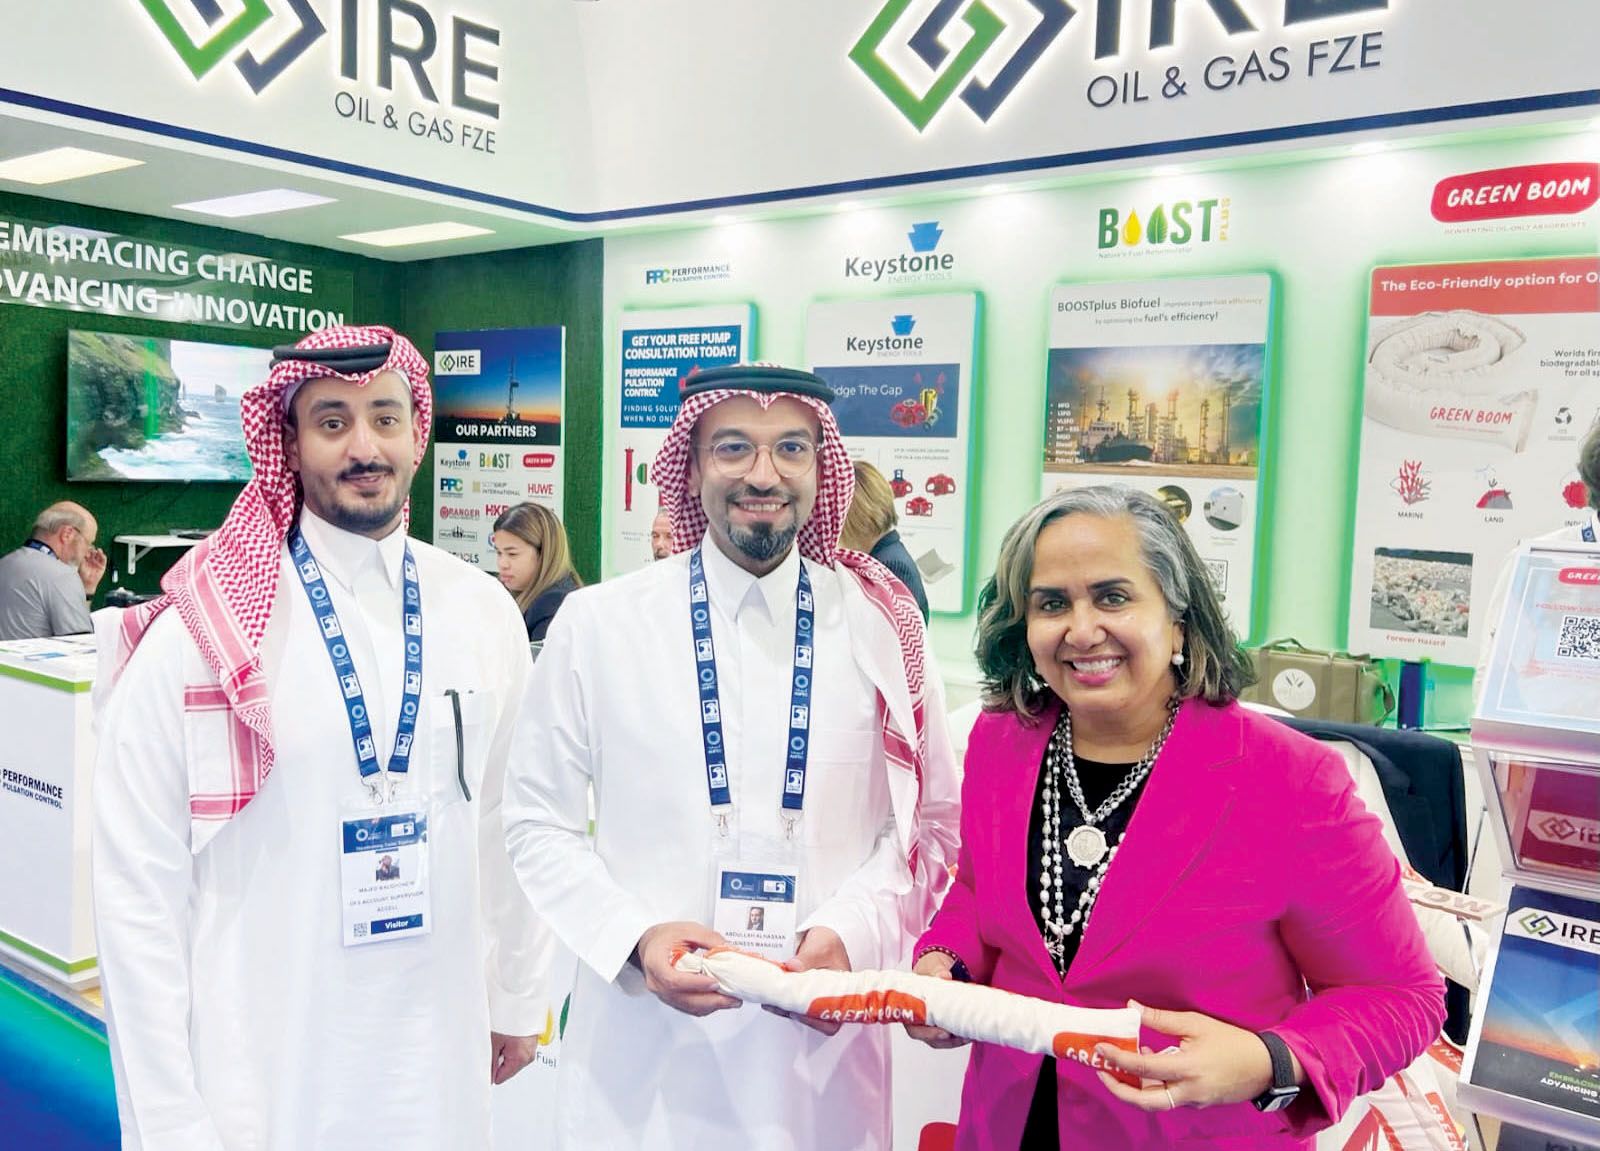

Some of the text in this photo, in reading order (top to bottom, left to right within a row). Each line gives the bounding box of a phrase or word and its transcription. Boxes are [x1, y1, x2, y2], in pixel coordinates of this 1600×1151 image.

[340, 0, 500, 119] IRE
[1087, 31, 1383, 107] OIL & GAS FZE
[334, 91, 496, 154] OIL & GAS FZE
[1447, 176, 1591, 208] GREEN BOOM
[0, 221, 313, 295] EMBRACING CHANGE
[672, 264, 730, 276] PERFORMANCE
[845, 253, 954, 282] Keystone
[646, 268, 671, 285] PPC
[1381, 281, 1407, 292] The
[1410, 275, 1502, 292] Eco-Friendly
[1505, 272, 1555, 290] option
[1558, 272, 1583, 285] for
[0, 269, 344, 332] VANCING INNOVATION
[1057, 299, 1117, 313] BOOSTplus
[1120, 297, 1160, 309] Biofuel
[1170, 311, 1218, 322] efficiency!
[632, 332, 731, 347] GET YOUR FREE PUMP
[847, 336, 923, 355] Keystone
[625, 345, 737, 360] CONSULTATION TODAY!
[1555, 349, 1585, 358] Worlds
[456, 355, 475, 368] IRE
[1540, 359, 1600, 368] biodegradabl
[624, 367, 677, 378] PERFORMANCE
[1564, 369, 1577, 377] for
[1579, 369, 1591, 377] oil
[624, 377, 665, 388] PULSATION
[857, 384, 878, 396] The
[880, 384, 903, 398] Gap
[624, 404, 653, 412] FINDING
[1429, 406, 1513, 425] GREEN BOOM
[624, 415, 644, 423] WHEN
[659, 415, 674, 423] ONE
[456, 424, 537, 438] OUR PARTNERS
[440, 478, 463, 491] PPC
[528, 483, 554, 495] HUWE
[1397, 512, 1424, 520] MARINE
[1484, 516, 1504, 524] LAND
[3, 769, 63, 800] PERFORMANCE
[3, 782, 62, 810] PULSATION CONTROL
[384, 920, 409, 930] Visitor
[1561, 921, 1600, 947] IRE
[820, 1004, 873, 1021] GREEN
[536, 1051, 557, 1068] Fuel
[1066, 1046, 1128, 1074] GRE
[1541, 1077, 1598, 1097] ADVANCING
